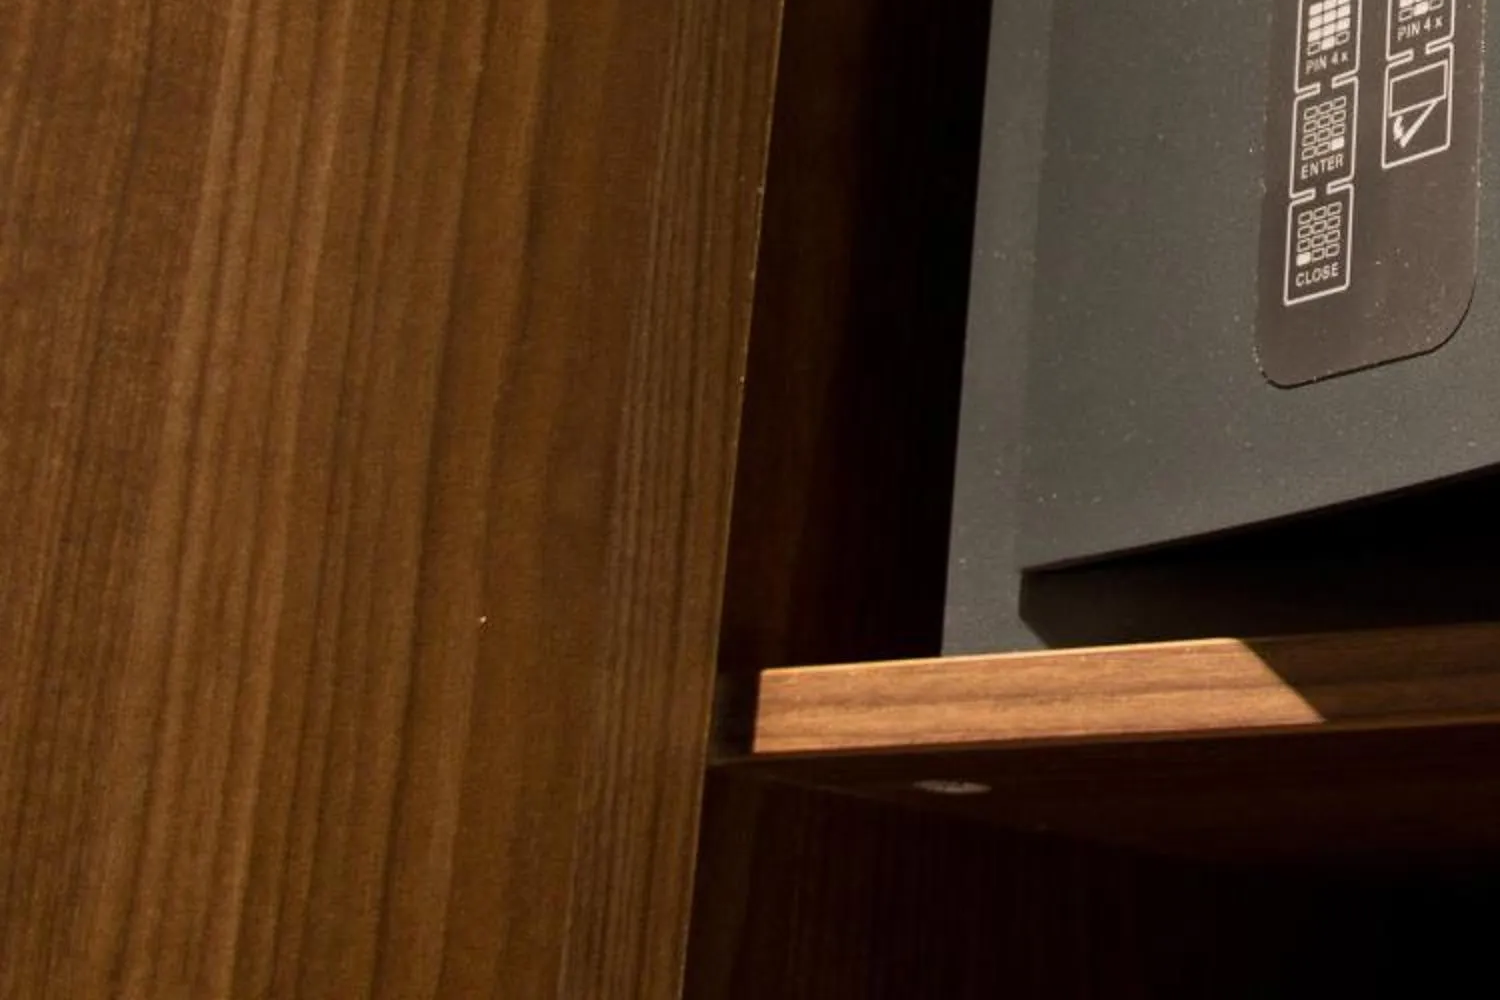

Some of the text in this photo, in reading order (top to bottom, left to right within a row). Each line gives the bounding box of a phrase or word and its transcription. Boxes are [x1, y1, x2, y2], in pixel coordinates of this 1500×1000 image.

[1397, 21, 1421, 41] PIN
[1306, 55, 1327, 75] PIN
[1300, 153, 1344, 180] ENTER
[1295, 262, 1339, 287] CLOSE
